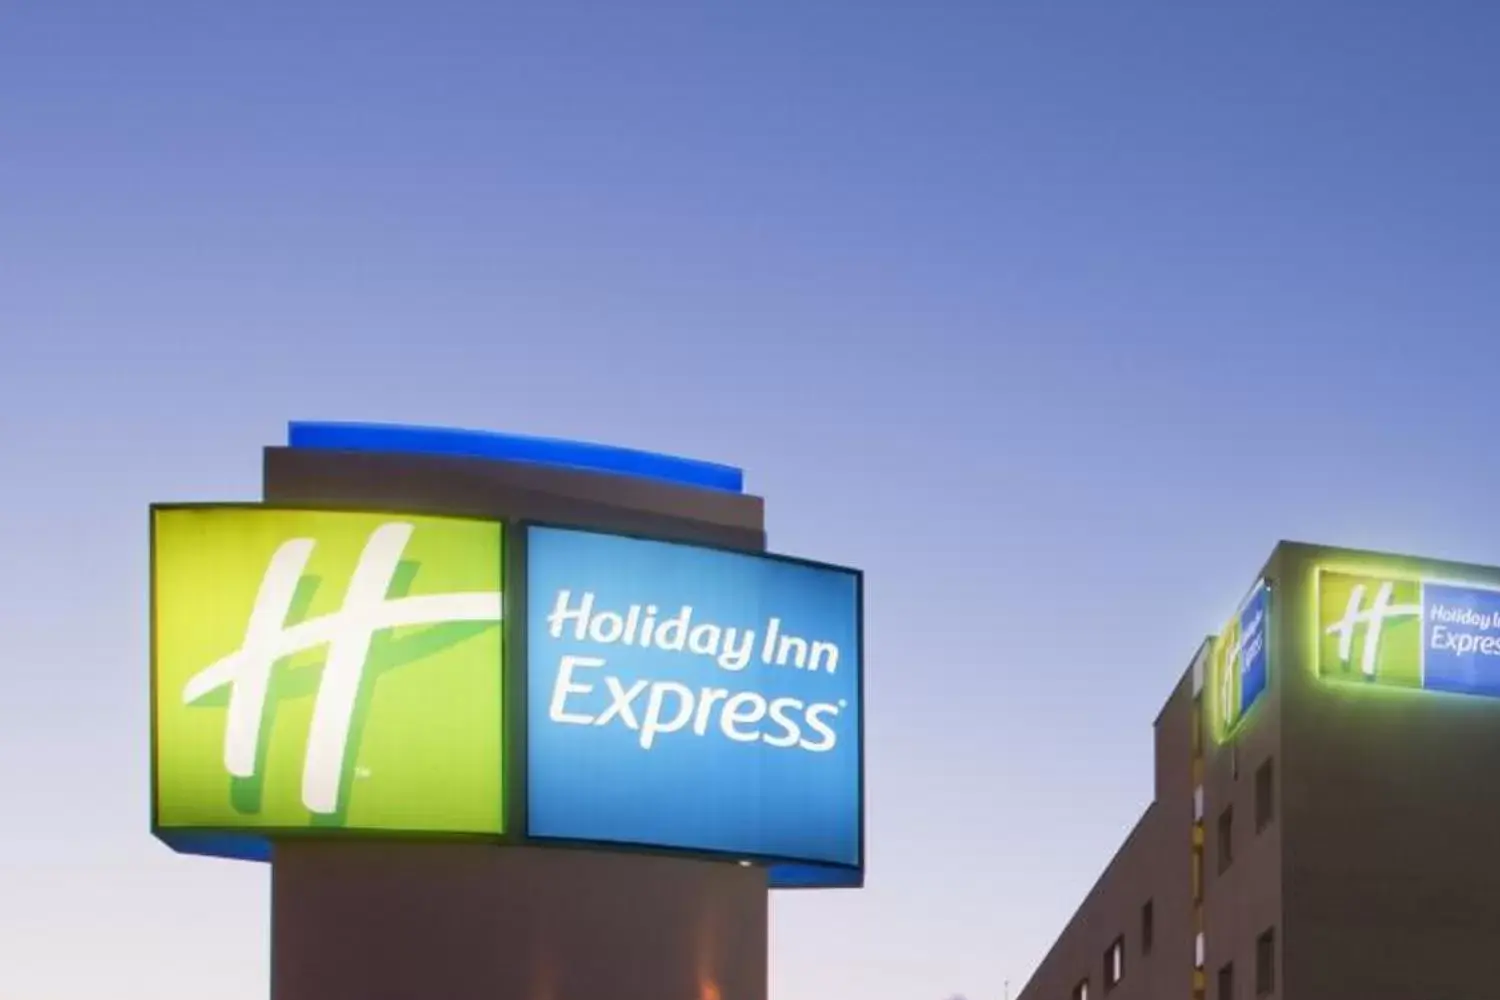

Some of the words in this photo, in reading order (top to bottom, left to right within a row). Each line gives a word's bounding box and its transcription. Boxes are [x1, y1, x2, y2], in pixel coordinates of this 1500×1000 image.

[547, 590, 754, 670] Holiday
[762, 618, 838, 673] Inn
[1431, 604, 1492, 630] Holiday
[549, 656, 841, 752] Express
